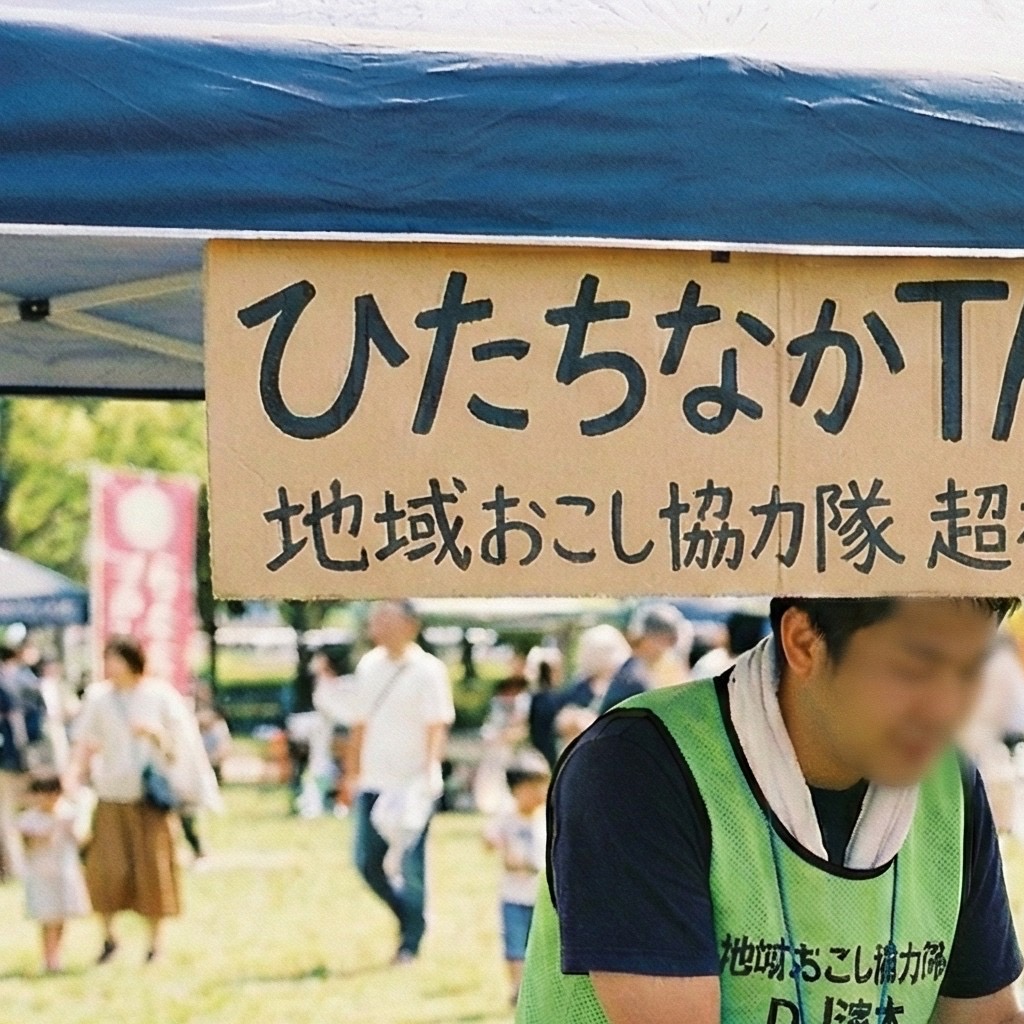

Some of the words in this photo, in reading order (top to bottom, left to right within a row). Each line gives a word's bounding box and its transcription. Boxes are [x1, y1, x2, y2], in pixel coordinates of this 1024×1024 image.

[263, 476, 906, 575] 地域おこし協力隊
